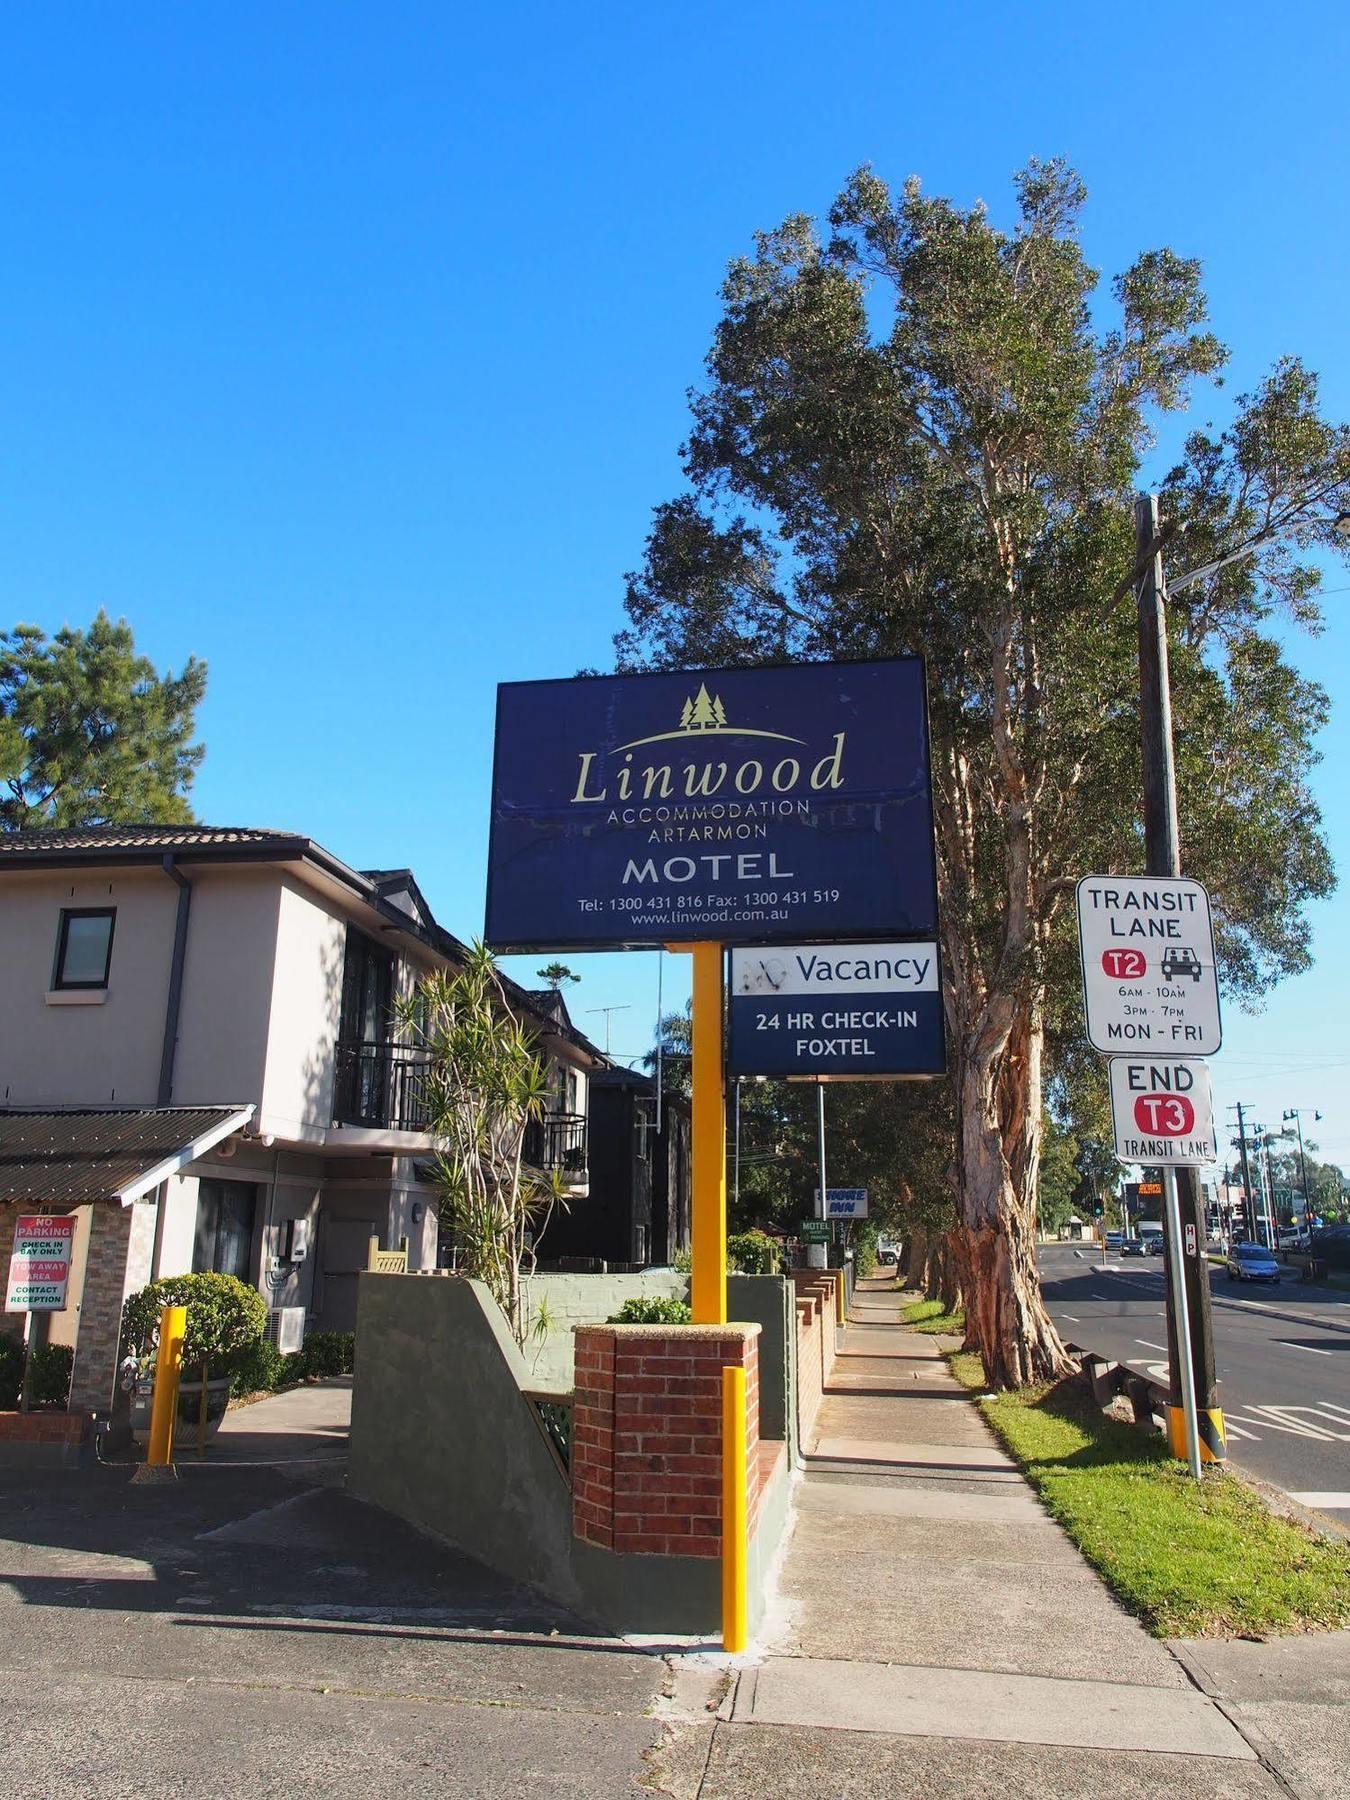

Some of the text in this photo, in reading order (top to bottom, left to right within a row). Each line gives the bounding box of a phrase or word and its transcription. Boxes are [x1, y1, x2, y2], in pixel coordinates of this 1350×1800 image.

[570, 732, 846, 803] Linwood
[607, 800, 810, 824] ACCOMMODATION
[648, 824, 767, 843] ARTARMON
[622, 853, 794, 885] MOTEL
[578, 890, 840, 912] Tel: 1300 431 816 Fax: 1300 431 519
[1088, 889, 1197, 912] TRANSIT
[631, 909, 789, 925] www.linwood.com.au
[1110, 917, 1182, 938] LANE
[796, 955, 931, 986] Vacancy
[1108, 952, 1141, 976] T2
[1118, 986, 1143, 997] 6AM
[1156, 986, 1186, 998] 10AM
[756, 1011, 918, 1030] 24 HR CHECK-IN
[1123, 1005, 1148, 1016] 3PM
[1161, 1006, 1185, 1017] 7PM
[1108, 1023, 1151, 1039] MON
[1172, 1025, 1203, 1041] FRI
[796, 1038, 875, 1056] FOXTEL
[1127, 1065, 1194, 1091] END
[1143, 1099, 1186, 1132] T3
[1124, 1140, 1209, 1157] TRANSIT LANE
[18, 1227, 70, 1236] PARKING
[35, 1218, 53, 1227] NO
[802, 1222, 830, 1230] MOTEL
[10, 1295, 61, 1303] RECEPTION
